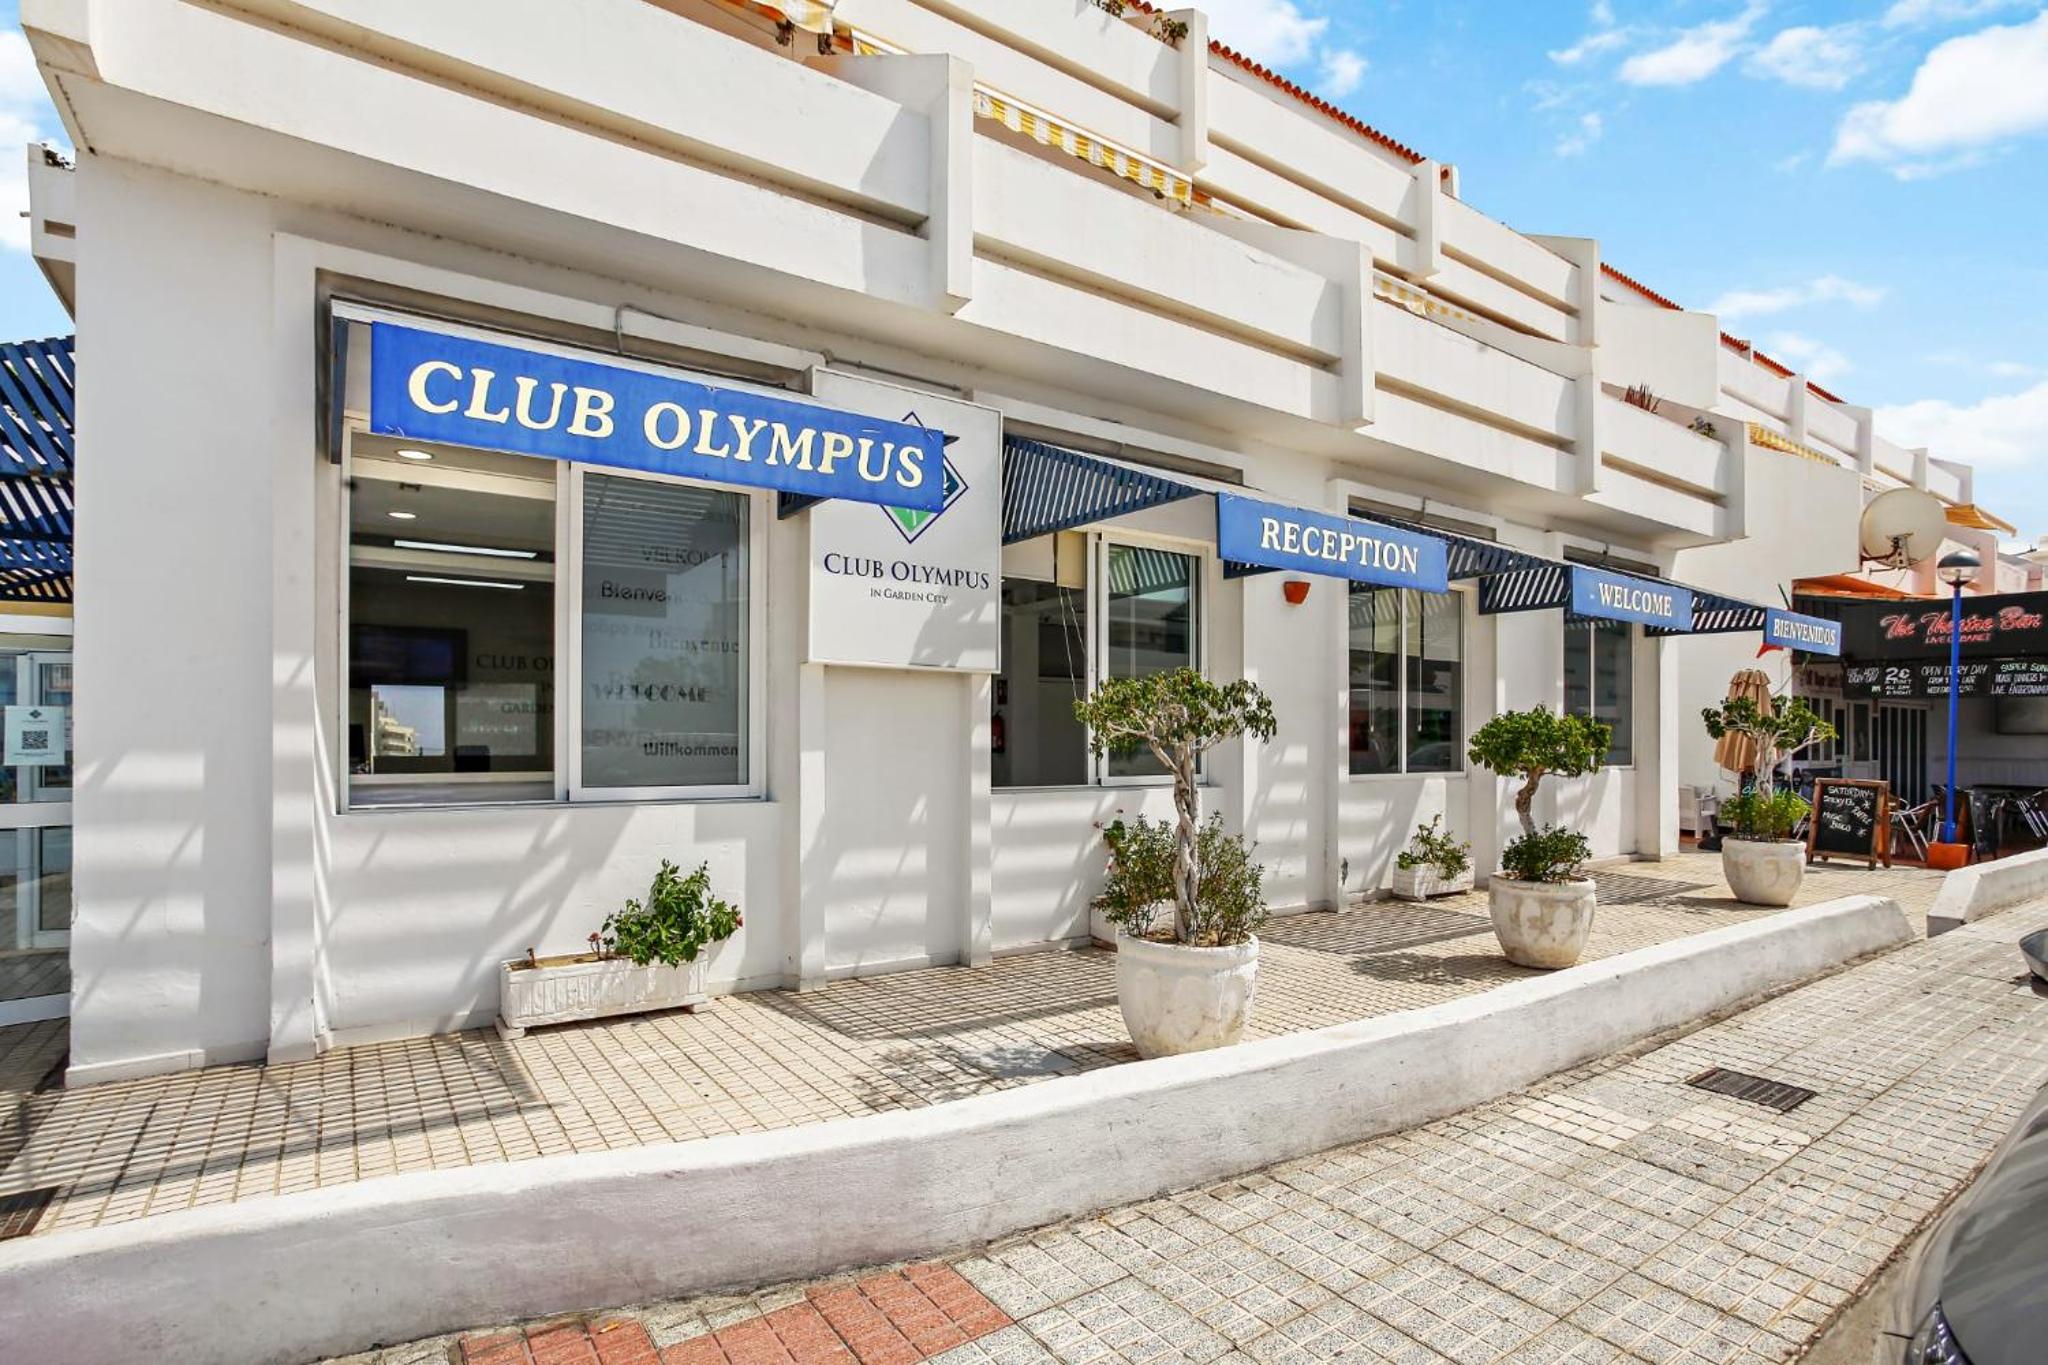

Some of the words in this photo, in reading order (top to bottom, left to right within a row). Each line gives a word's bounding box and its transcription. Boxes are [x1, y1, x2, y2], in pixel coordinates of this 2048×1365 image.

[408, 361, 615, 439] CLUB
[643, 401, 925, 489] OLYMPUS
[1261, 518, 1419, 574] RECEPTION
[824, 553, 884, 579] CLUB
[891, 561, 990, 590] OLYMPUS
[870, 588, 881, 597] IN
[884, 588, 924, 602] GARDEN
[1598, 583, 1672, 617] WELCOME
[1773, 618, 1836, 646] BIENVENIDOS
[1880, 613, 1916, 640] The
[1998, 606, 2043, 631] Bar
[476, 653, 528, 671] CLUB
[1970, 664, 1988, 675] DAY
